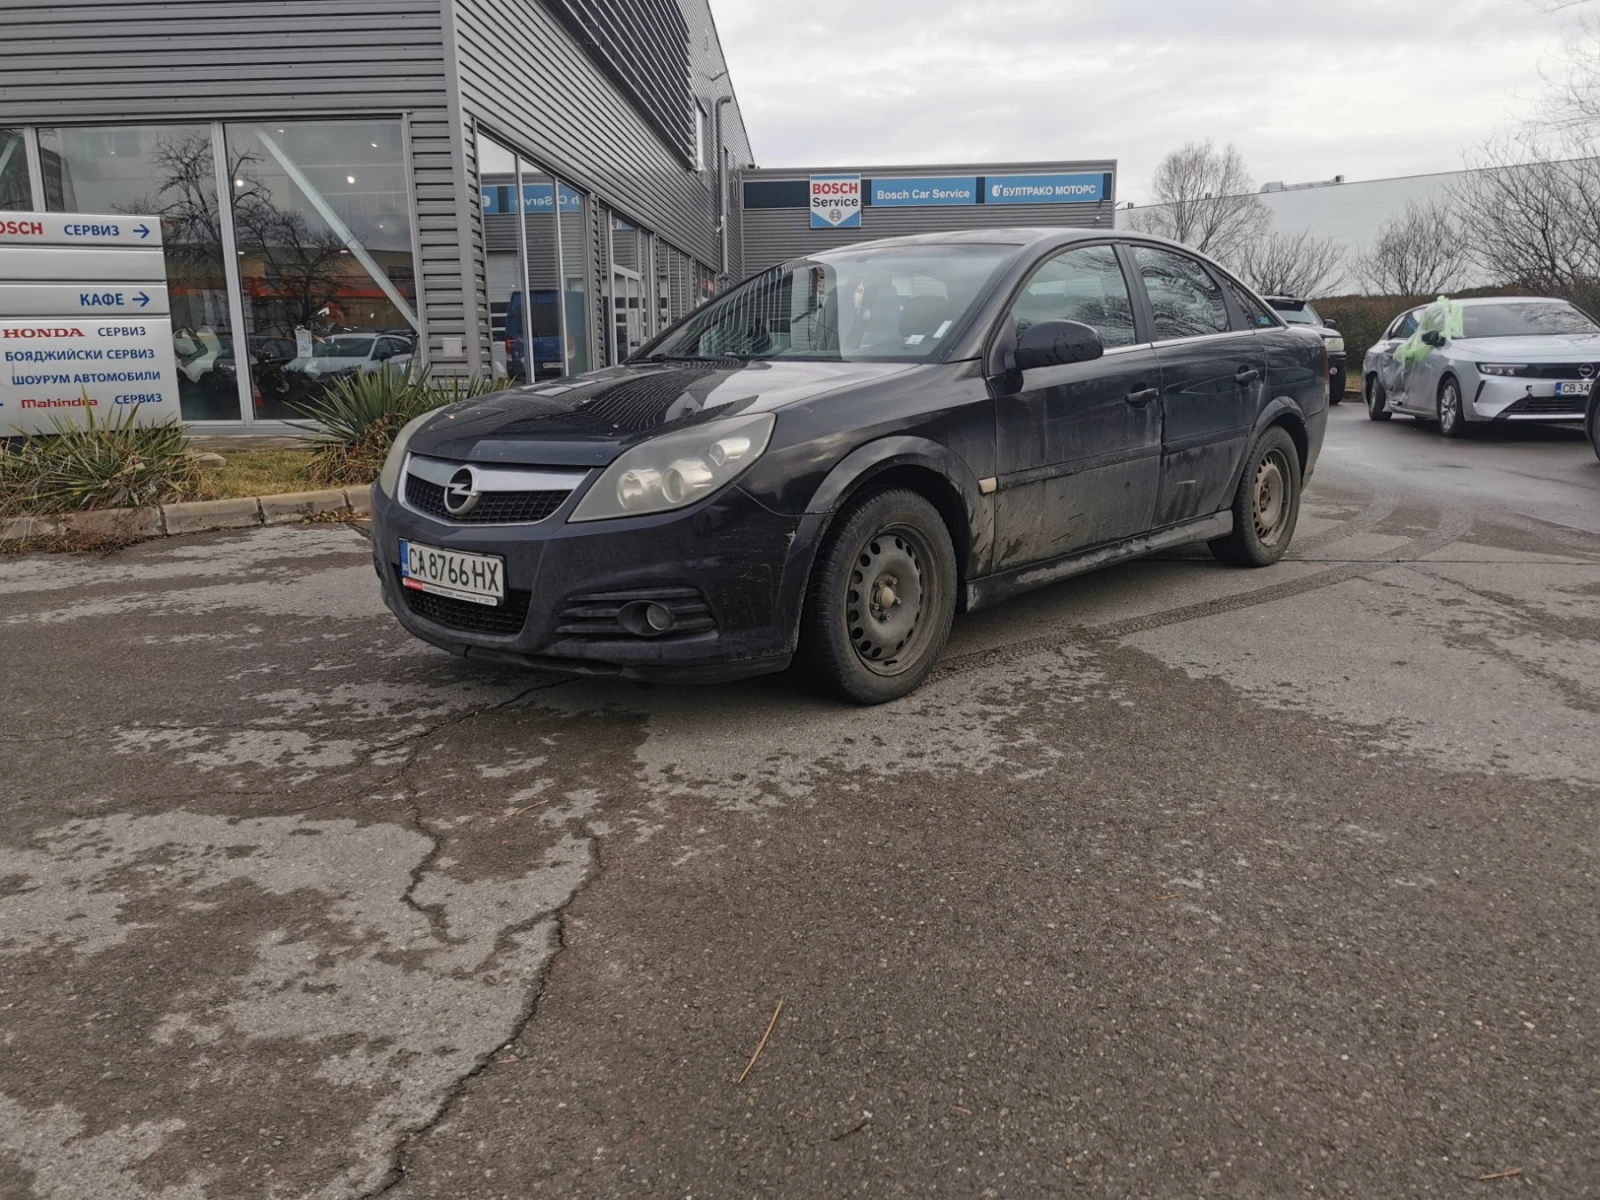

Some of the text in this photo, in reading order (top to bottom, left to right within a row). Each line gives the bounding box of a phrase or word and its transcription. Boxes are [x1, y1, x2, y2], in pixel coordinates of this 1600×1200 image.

[812, 183, 858, 195] BOSCH
[877, 188, 971, 200] Bosch Car Service
[1003, 184, 1096, 197] БУЛТРАКО МОТОРС
[812, 196, 859, 208] Service
[63, 224, 120, 237] СЕРВИЗ
[79, 293, 125, 307] КАФЕ
[2, 328, 85, 339] HONDA
[97, 326, 147, 337] СЕРВИЗ
[5, 349, 155, 363] БОЯДЖИЙСКИ СЕРВИЗ
[12, 371, 161, 386] ШОУРУМ АВТОМОБИЛИ
[114, 393, 163, 405] СЕРВИЗ
